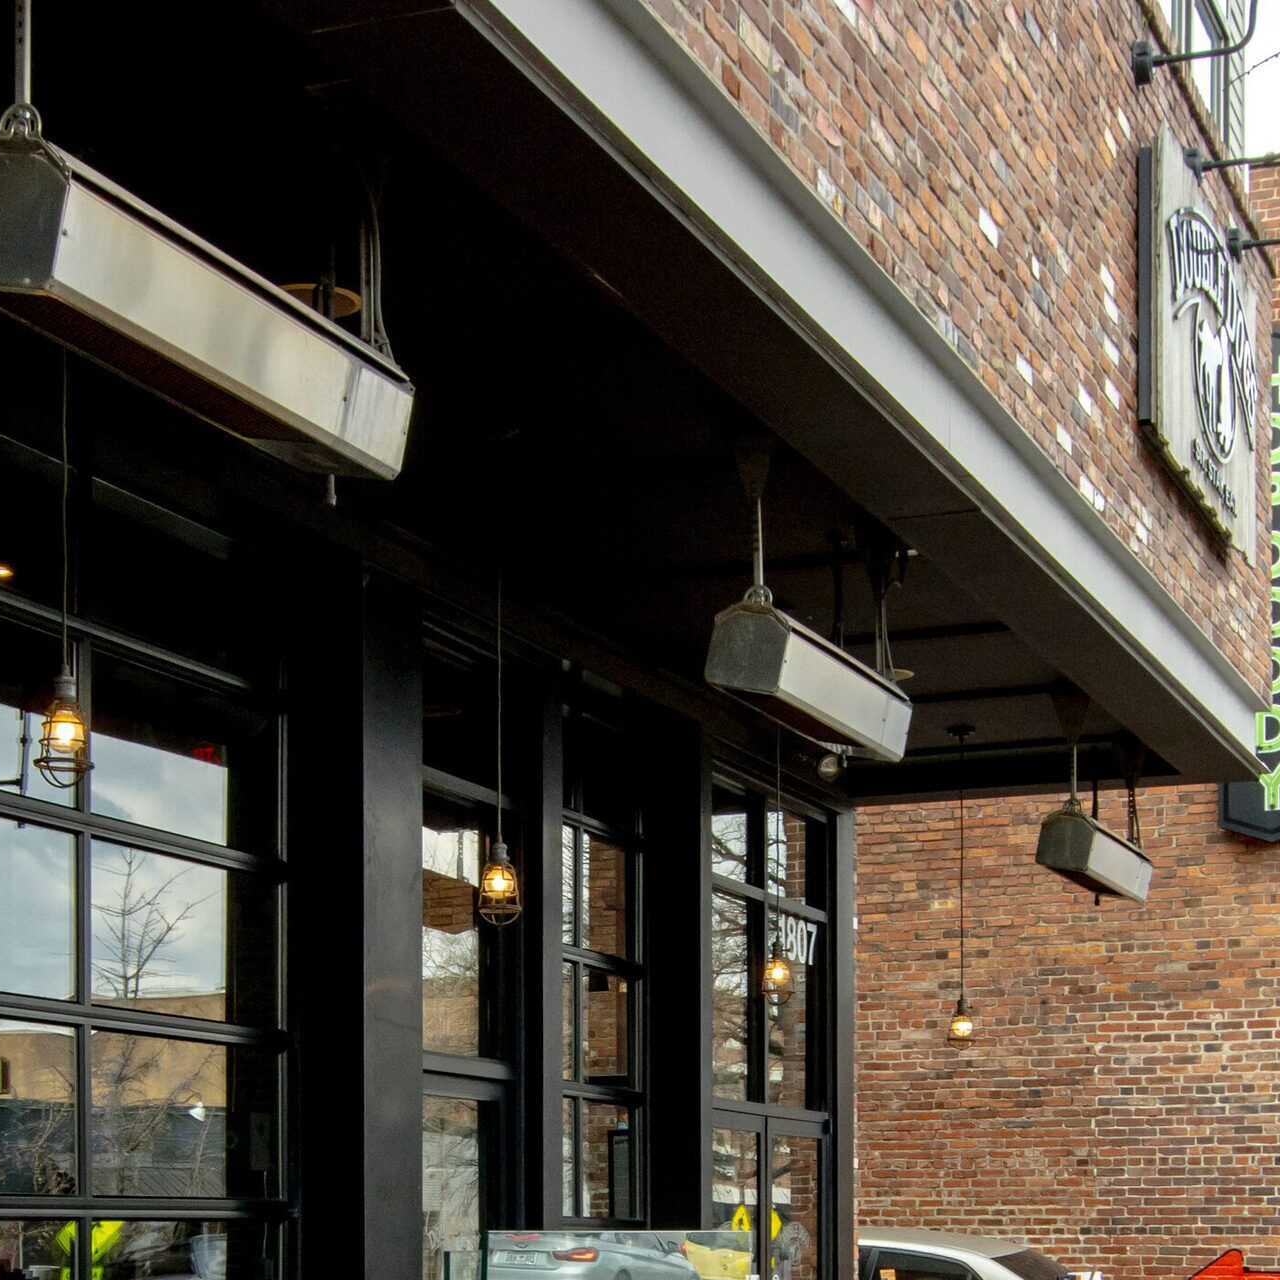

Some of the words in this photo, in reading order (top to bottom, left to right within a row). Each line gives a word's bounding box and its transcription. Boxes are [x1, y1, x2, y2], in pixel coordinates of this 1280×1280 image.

[1170, 216, 1228, 319] DOUBLE
[1226, 263, 1258, 429] DOGS
[778, 913, 818, 966] 1807
